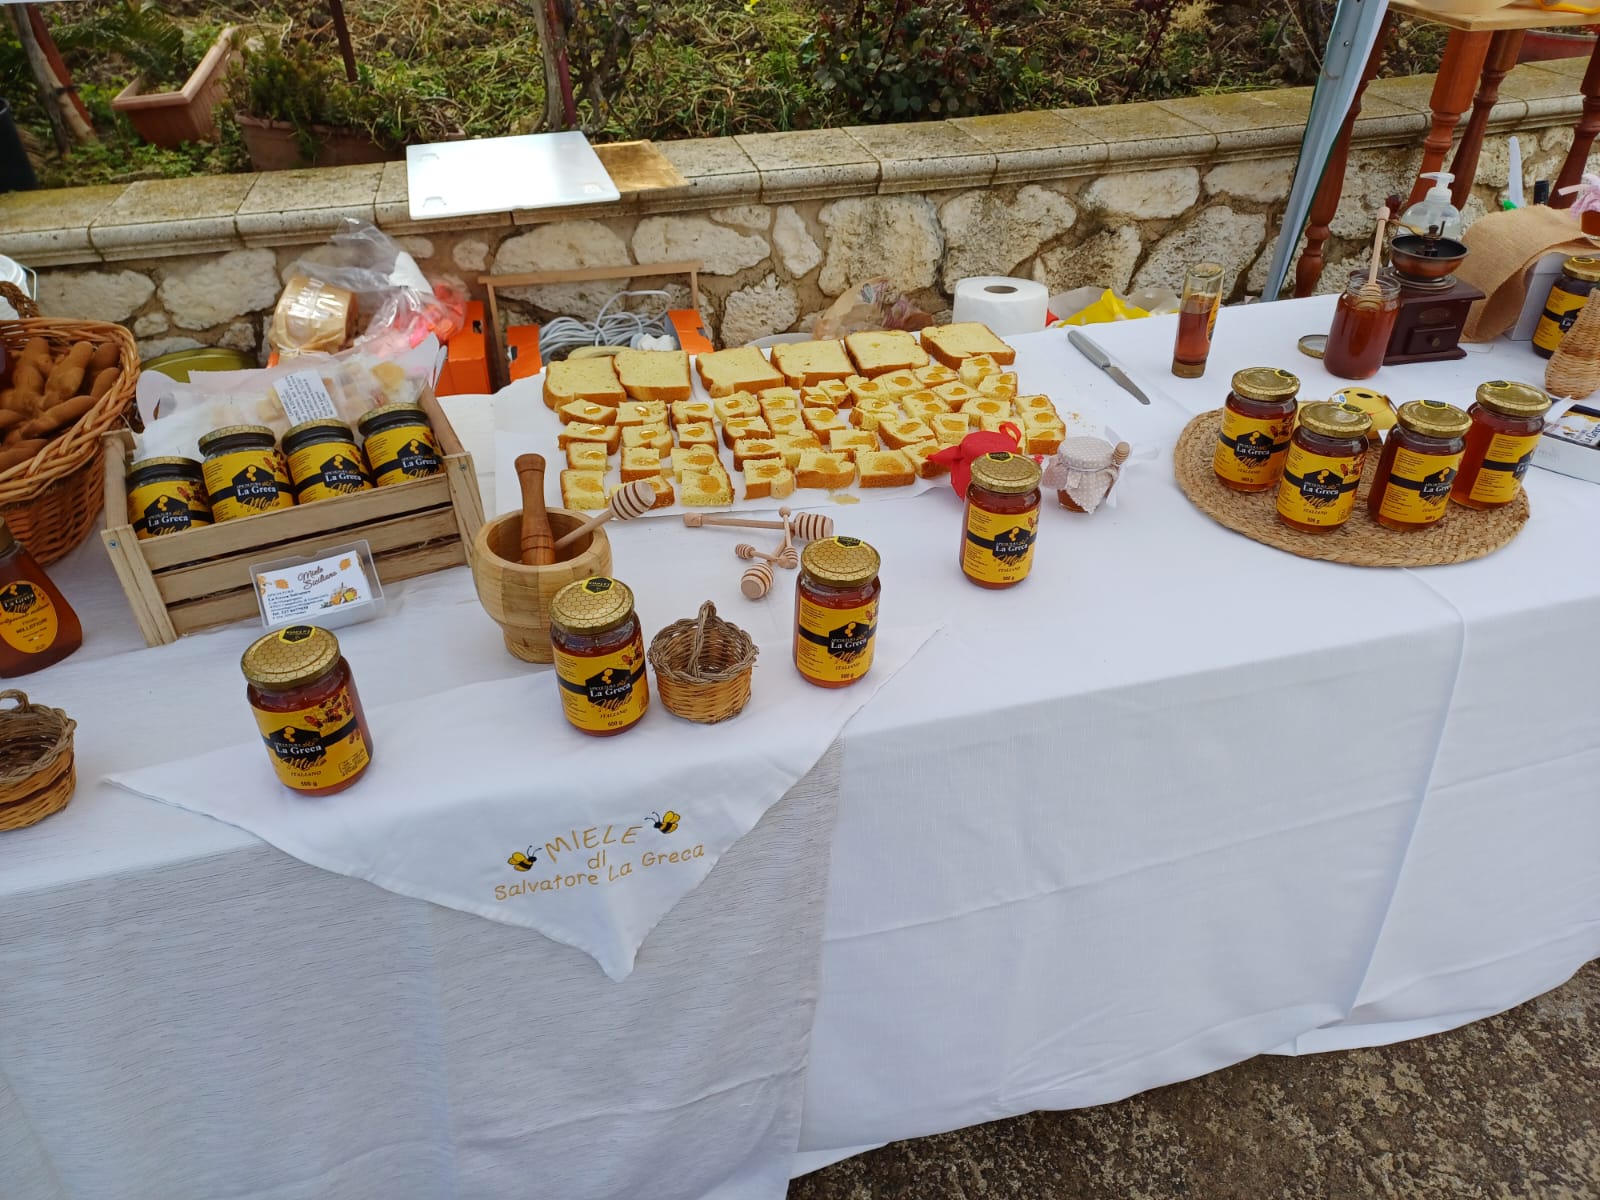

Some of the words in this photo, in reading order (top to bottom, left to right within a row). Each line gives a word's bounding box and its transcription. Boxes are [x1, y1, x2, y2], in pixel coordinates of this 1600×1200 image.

[1236, 445, 1246, 454] La
[402, 460, 414, 468] La
[325, 474, 337, 482] La
[339, 472, 362, 481] Greca
[237, 487, 249, 496] La
[251, 486, 276, 494] Greca
[1303, 484, 1314, 493] La
[1315, 486, 1339, 496] Greca
[1423, 485, 1434, 493] La
[148, 519, 159, 528] La
[161, 515, 189, 524] Greca
[1008, 543, 1028, 552] Greca
[303, 571, 338, 590] Siciliano
[845, 638, 867, 649] Greca
[605, 683, 631, 696] Greca
[275, 745, 288, 754] La
[290, 744, 322, 755] Greca
[545, 824, 643, 864] MIELE
[494, 872, 600, 901] Salvatore
[608, 863, 633, 882] La
[641, 844, 705, 868] Greca
